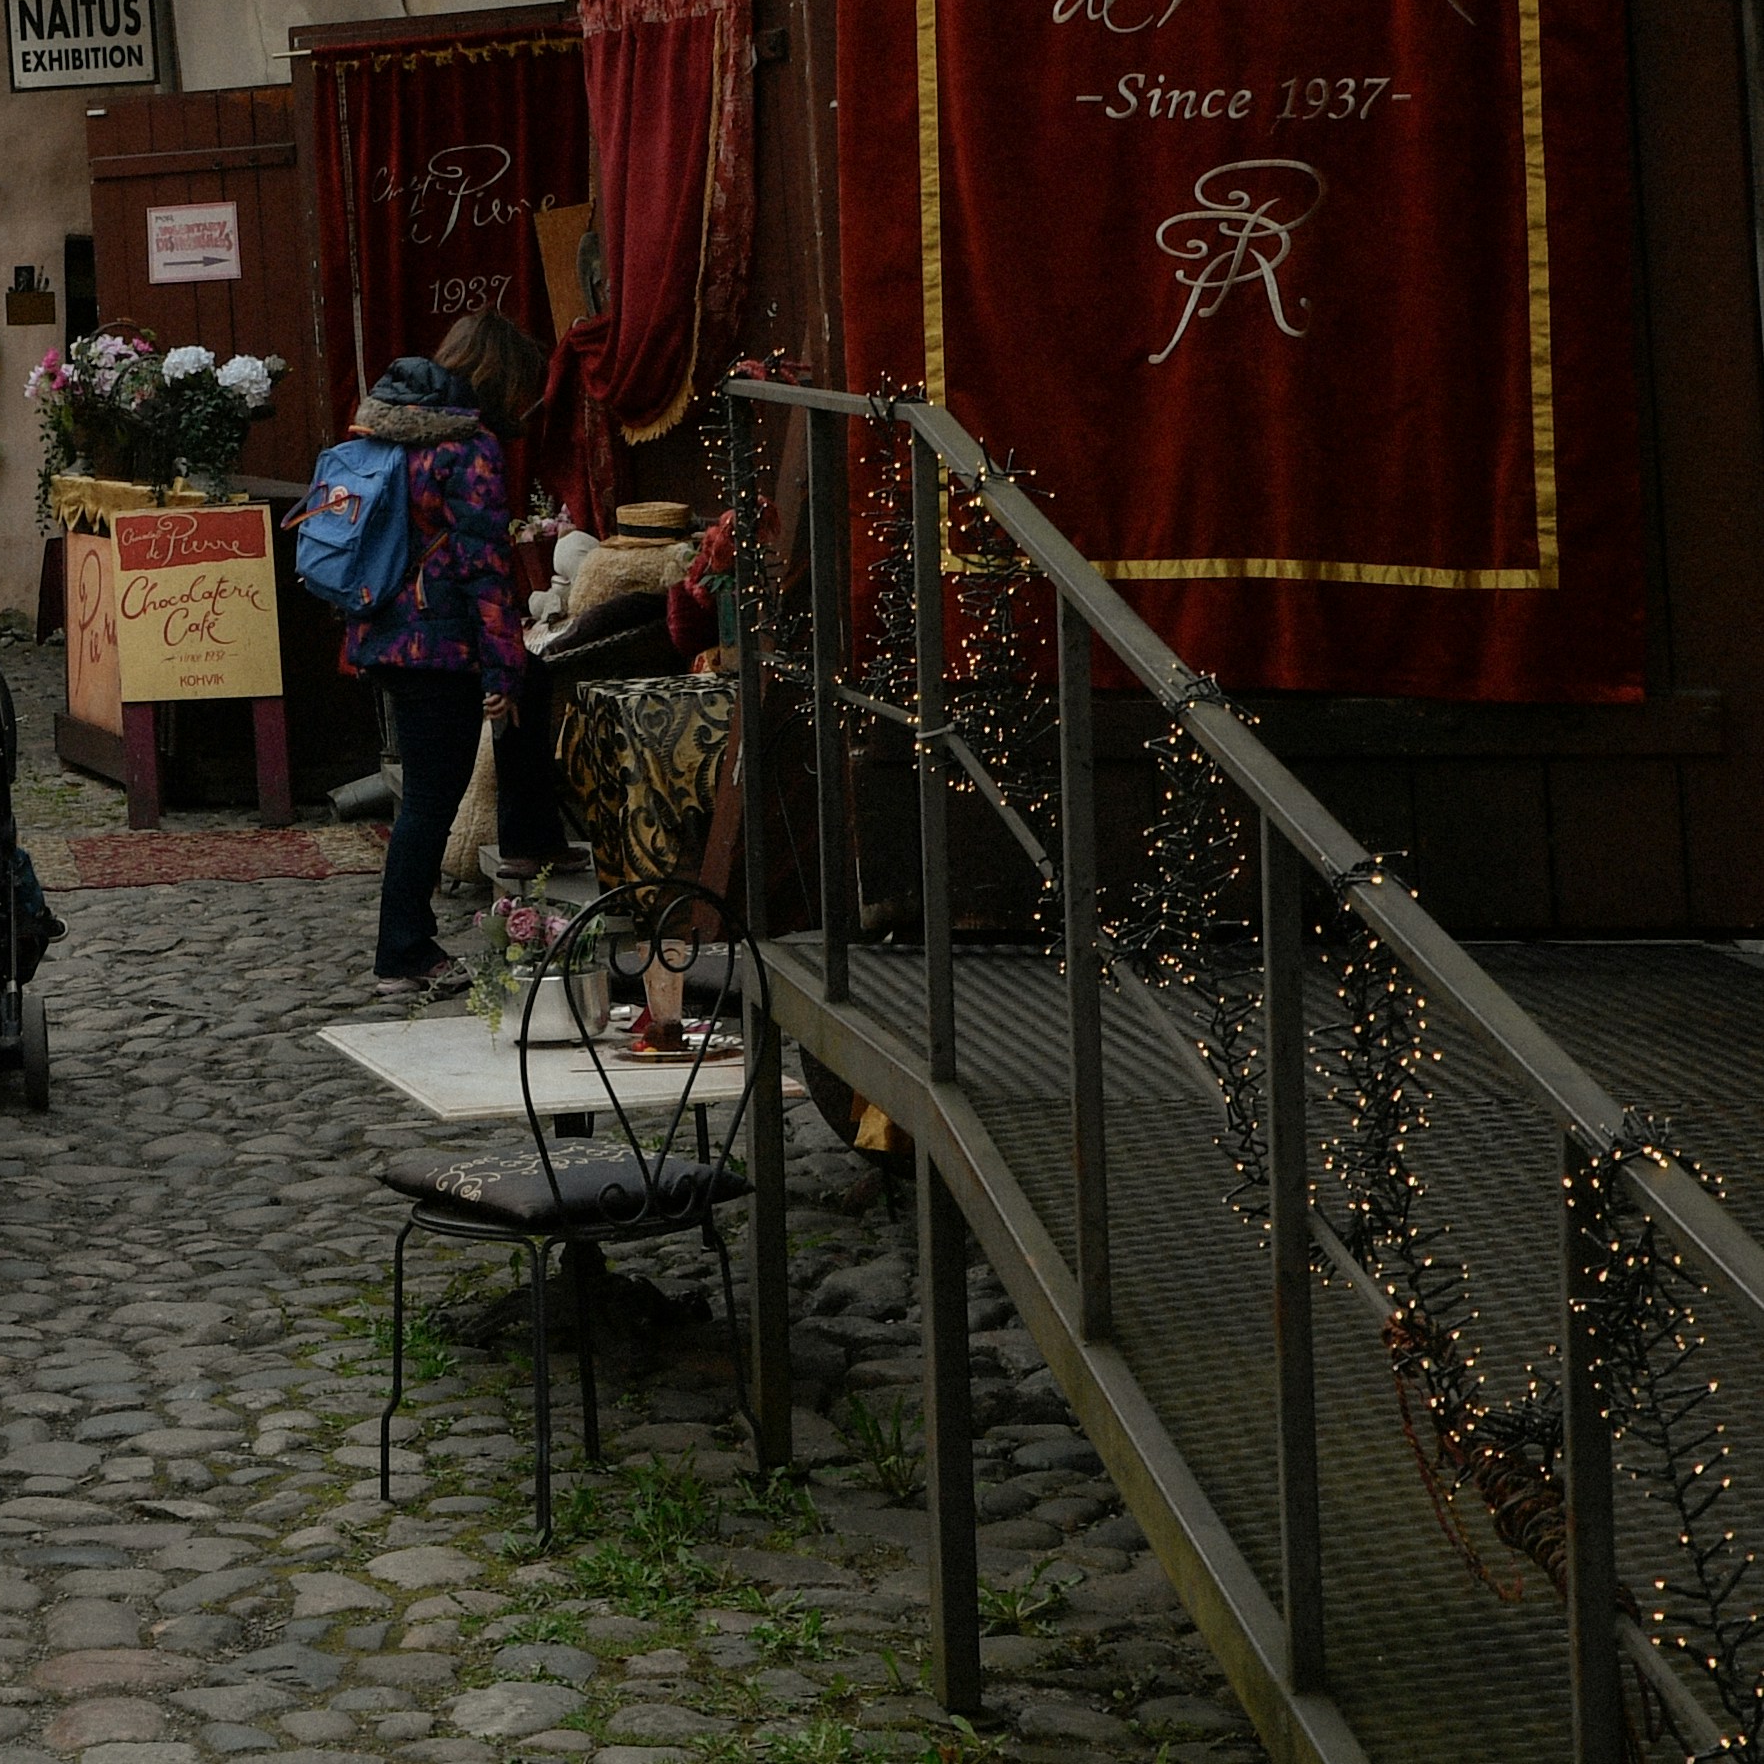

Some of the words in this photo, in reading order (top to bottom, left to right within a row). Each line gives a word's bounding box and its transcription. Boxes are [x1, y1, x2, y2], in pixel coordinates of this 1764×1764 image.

[22, 45, 143, 73] EXHIBITION
[429, 274, 512, 315] 1937
[157, 513, 257, 567] Pierre
[121, 575, 271, 619] Chocolaterie
[164, 607, 237, 646] Café
[180, 673, 225, 687] KOHVIK
